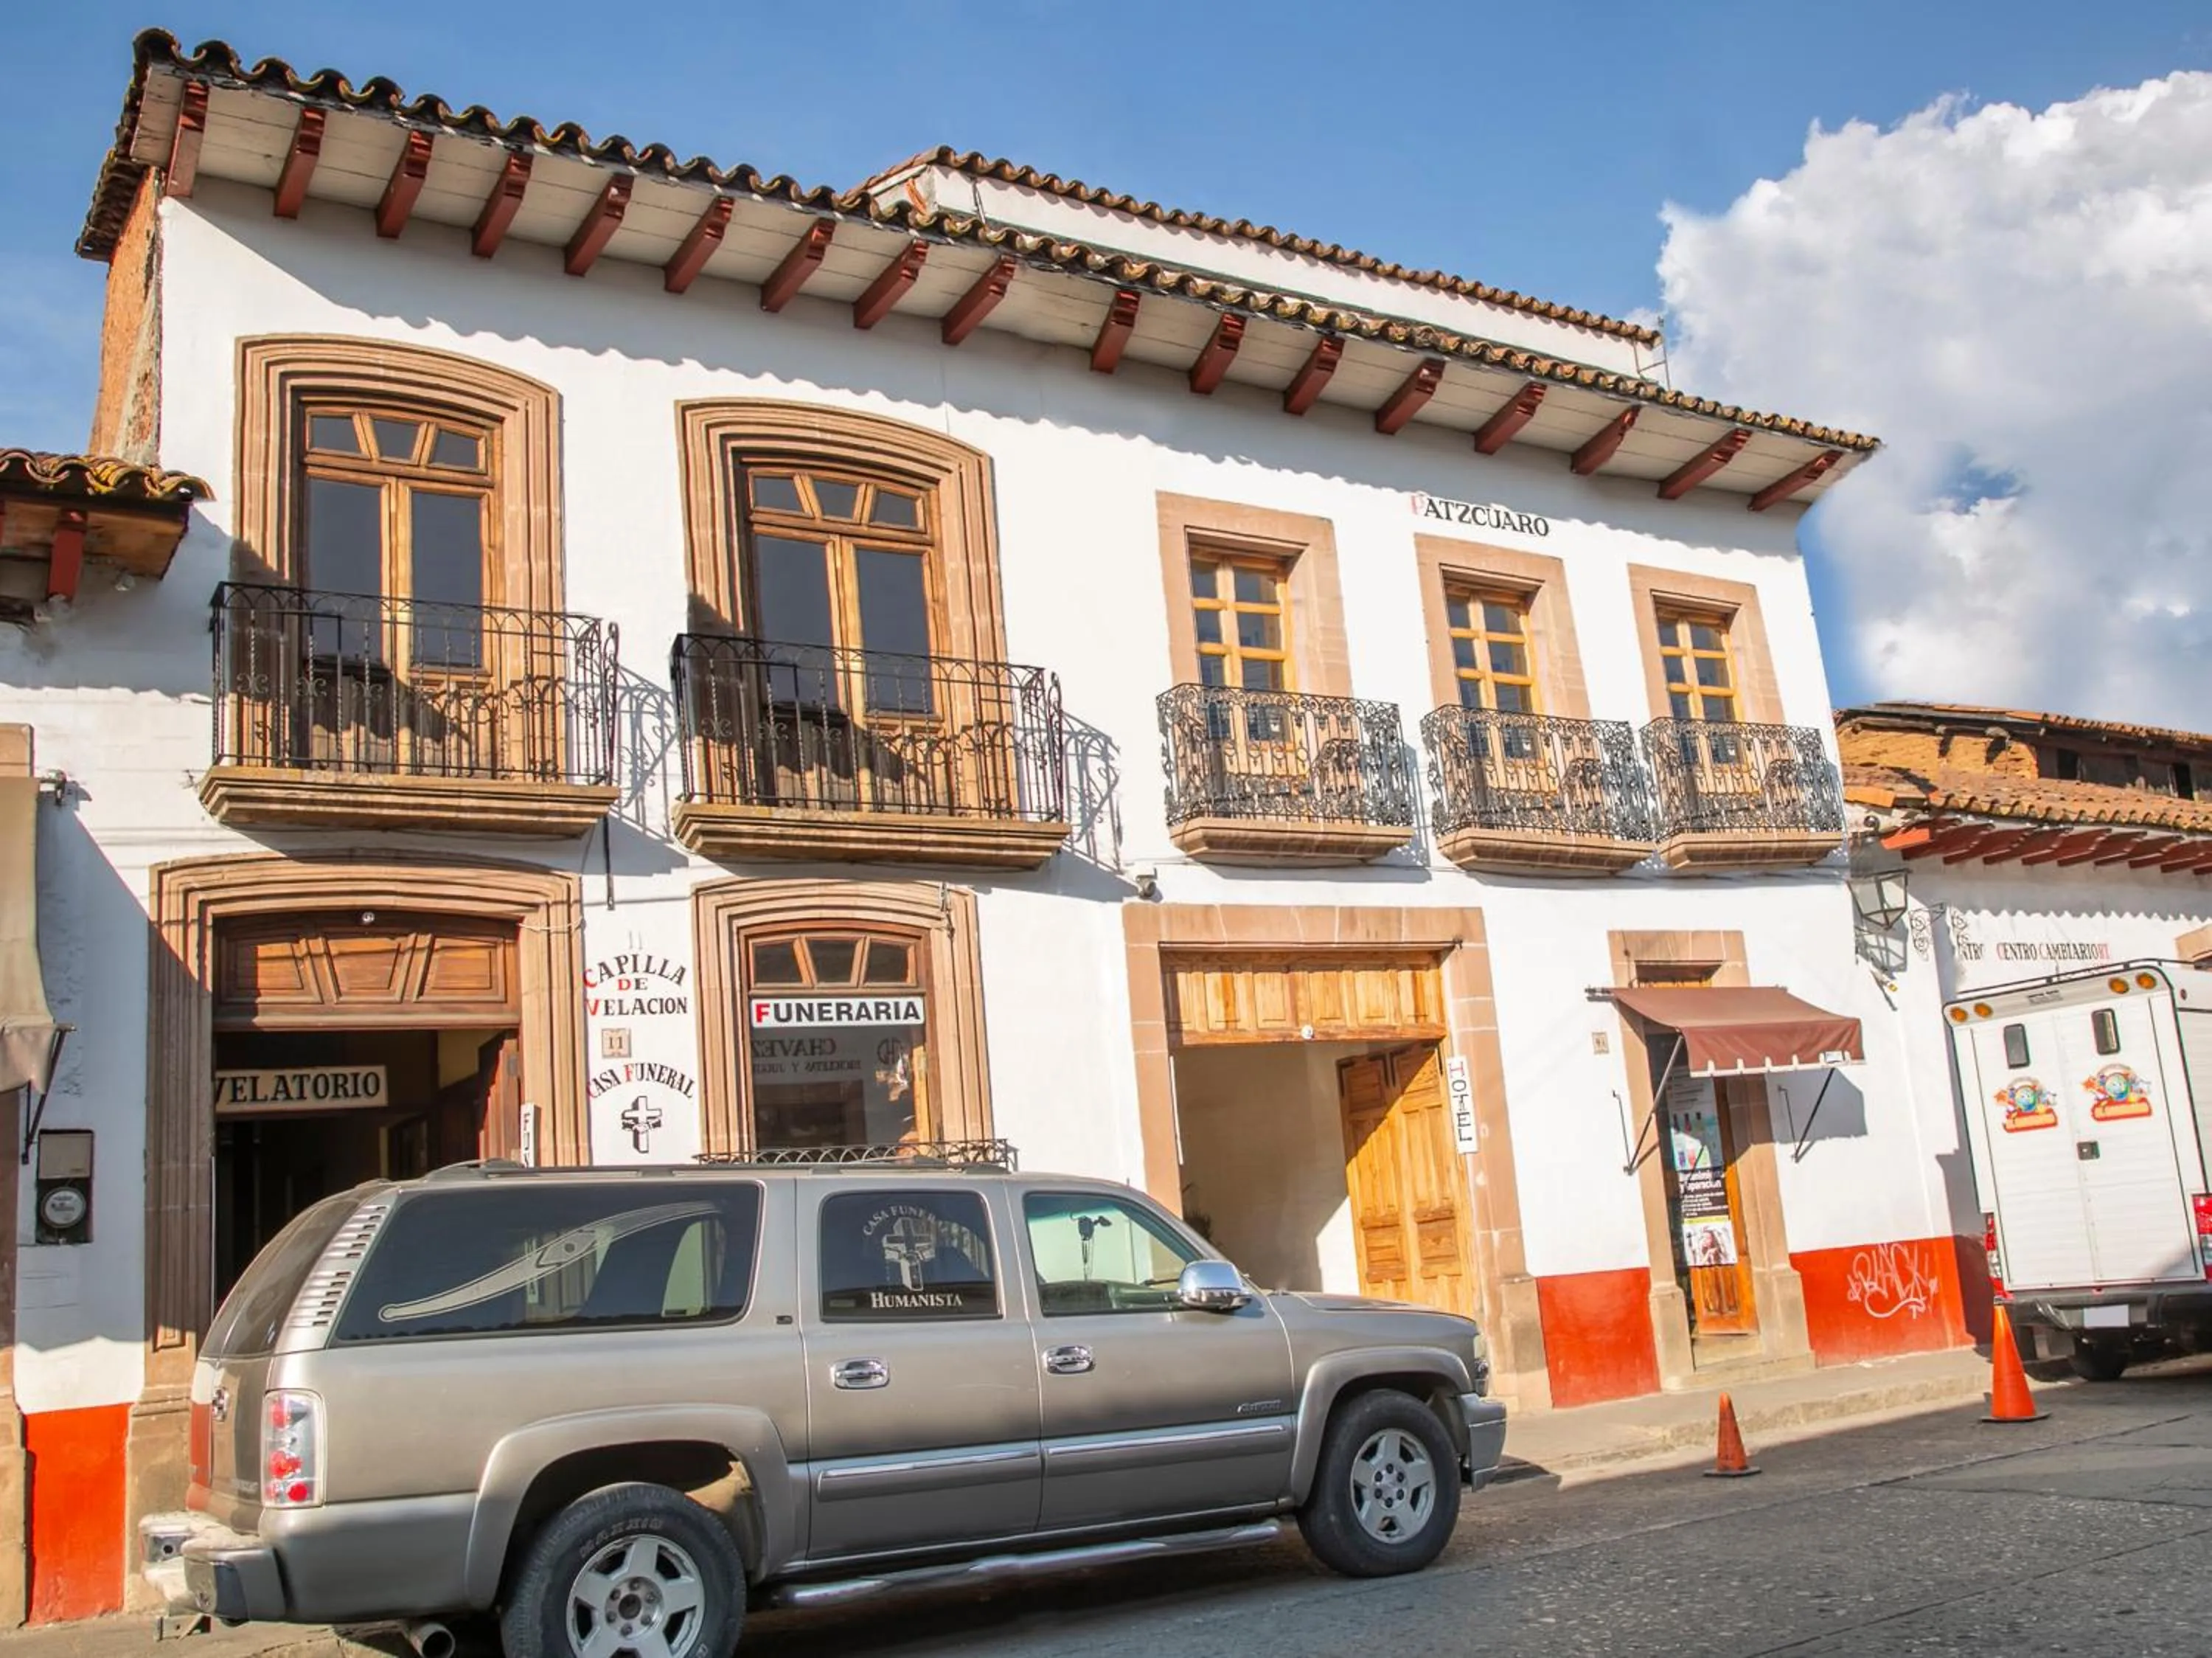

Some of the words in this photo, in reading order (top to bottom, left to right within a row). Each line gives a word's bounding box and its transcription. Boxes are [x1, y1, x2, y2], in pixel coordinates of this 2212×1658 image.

[1997, 943, 2037, 960] CENTRO
[583, 954, 686, 988] CAPILLA
[618, 978, 647, 991] DE
[585, 997, 687, 1016] VELACION
[756, 1002, 920, 1022] FUNERARIA
[609, 1037, 623, 1050] 11
[586, 1069, 621, 1098] CASA
[625, 1063, 695, 1098] FUNERAL
[1448, 1061, 1472, 1142] HOTEL
[863, 1210, 889, 1236] CASA
